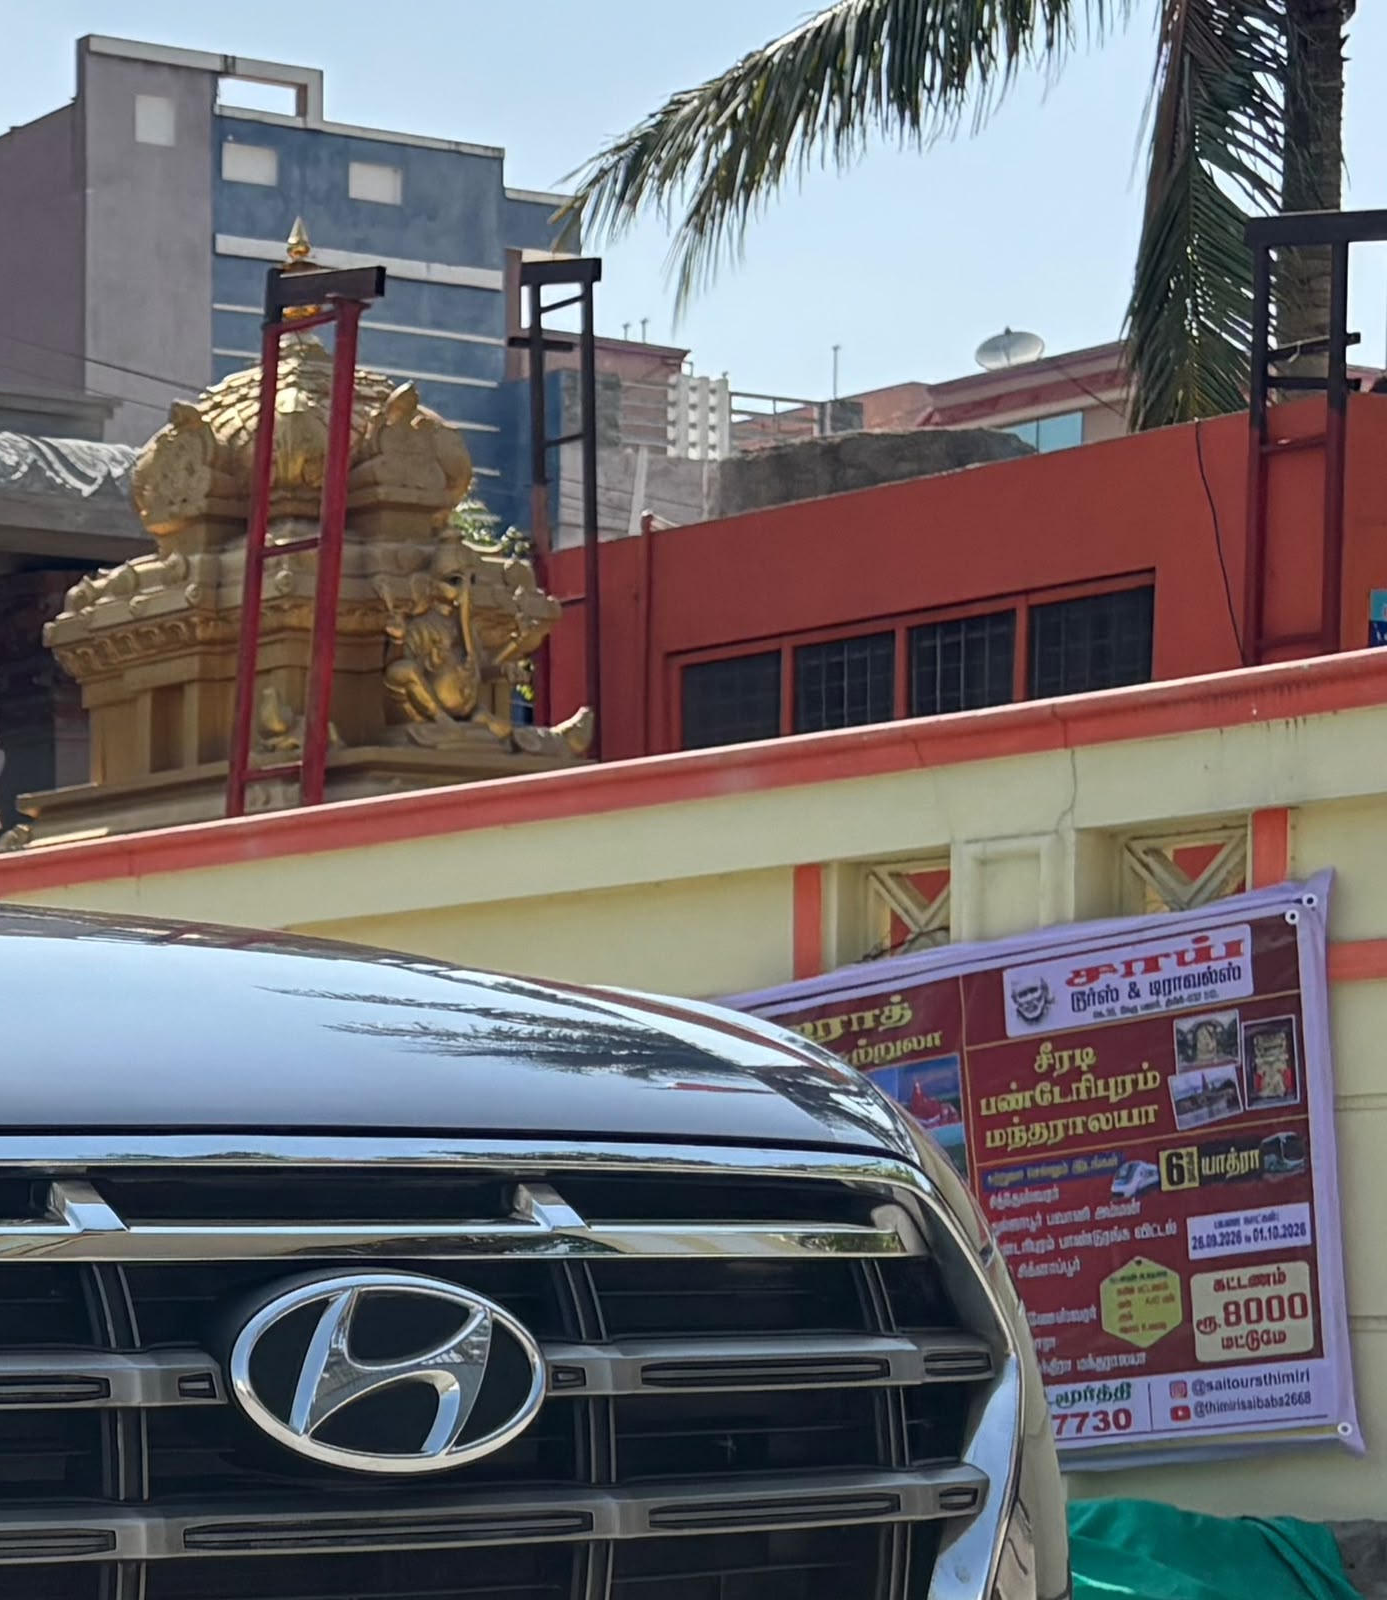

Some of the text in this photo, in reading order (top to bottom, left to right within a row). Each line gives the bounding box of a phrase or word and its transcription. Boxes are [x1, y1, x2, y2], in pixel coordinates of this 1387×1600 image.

[1065, 935, 1244, 987] சாய்
[1127, 982, 1142, 1000] &
[839, 1031, 942, 1066] ற்றுலா
[1034, 1041, 1096, 1077] சீரடி
[985, 1105, 1159, 1151] மந்தராலயா
[1165, 1152, 1186, 1186] 6
[1201, 1147, 1260, 1180] யாத்ரா
[1213, 1266, 1287, 1293] கட்டணம்
[1221, 1329, 1287, 1351] மட்டுமே
[1191, 1369, 1311, 1397] @saitoursthimiri
